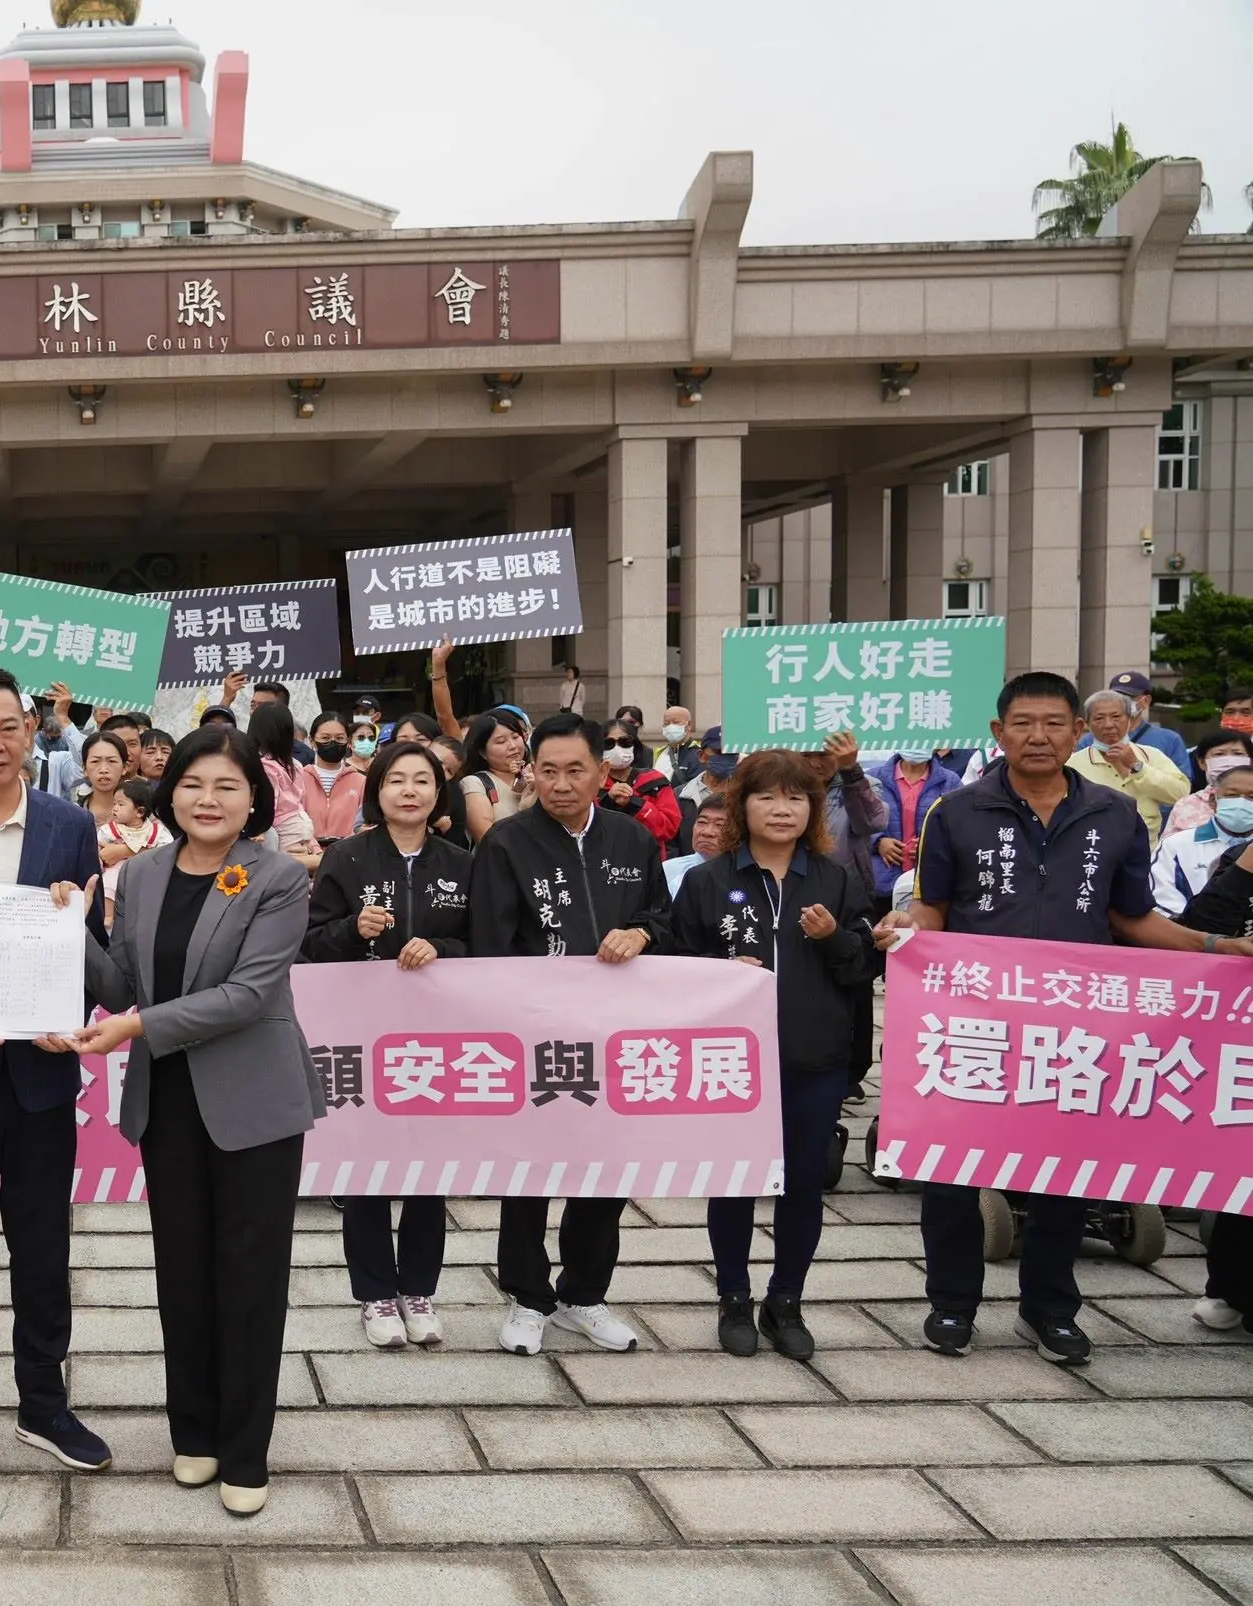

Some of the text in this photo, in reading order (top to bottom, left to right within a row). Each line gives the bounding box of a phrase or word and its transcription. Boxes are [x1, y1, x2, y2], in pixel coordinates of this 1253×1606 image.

[39, 328, 363, 353] Yunlin County Council
[363, 549, 562, 594] 人行道不是阻礙
[174, 600, 302, 639] 提升區域
[368, 588, 560, 631] 是城市的進步!
[193, 640, 286, 673] 競爭力
[765, 637, 953, 684] 行人好走
[766, 690, 953, 734] 商家好賺
[976, 849, 995, 911] 何錦龍
[998, 827, 1016, 894] 榴南里長
[1076, 829, 1101, 913] 斗六市公所
[554, 868, 572, 907] 主席
[533, 878, 567, 957] 胡克勤
[741, 905, 759, 944] 代表
